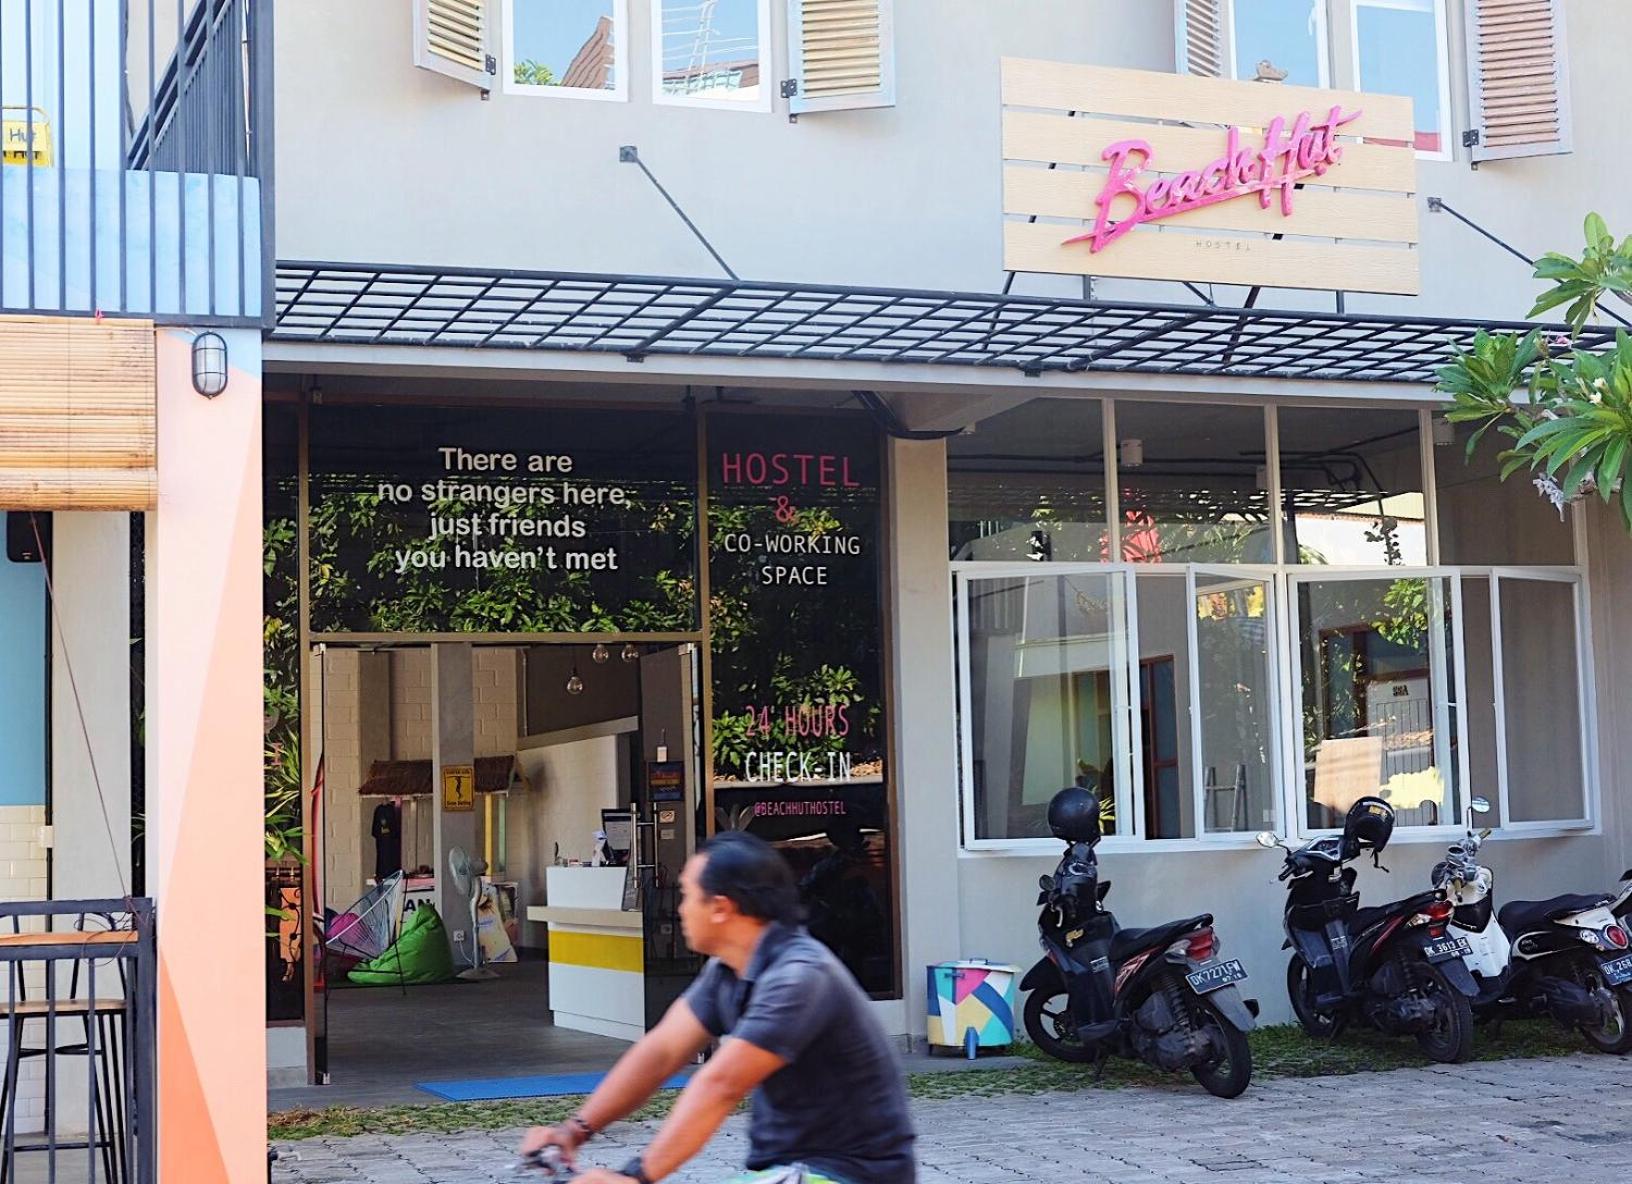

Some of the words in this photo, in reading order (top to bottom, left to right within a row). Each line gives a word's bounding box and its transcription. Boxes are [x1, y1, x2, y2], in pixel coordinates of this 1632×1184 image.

[1061, 125, 1256, 254] Beach
[1257, 105, 1362, 217] Hut
[1194, 239, 1251, 252] HOSTEL
[438, 447, 517, 471] There
[527, 454, 573, 472] are
[722, 452, 860, 487] HOSTEL
[377, 483, 413, 502] no
[421, 479, 555, 508] strangers
[775, 495, 796, 523] &
[428, 512, 482, 541] just
[488, 512, 586, 538] friends
[724, 533, 861, 555] CO-WORKING
[395, 549, 446, 574] you
[565, 547, 618, 570] met
[761, 566, 828, 585] SPACE
[745, 704, 771, 737] 24
[785, 704, 849, 737] HOURS
[745, 751, 851, 783] CHECK-IN
[754, 801, 847, 817] @BEACHHUTHOSTEL
